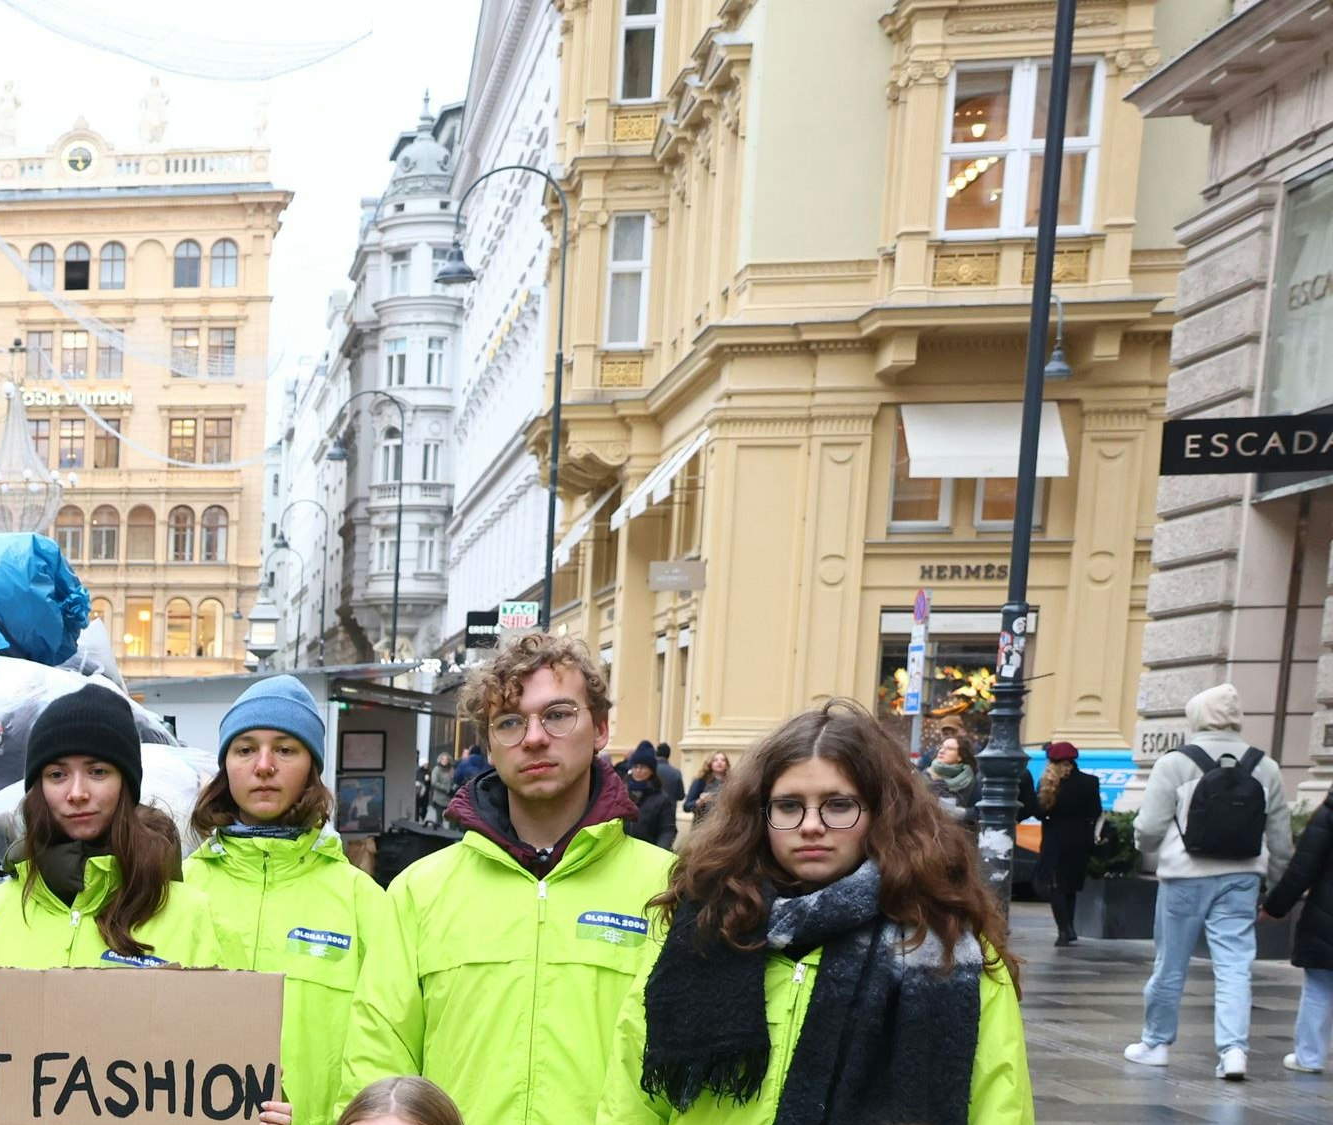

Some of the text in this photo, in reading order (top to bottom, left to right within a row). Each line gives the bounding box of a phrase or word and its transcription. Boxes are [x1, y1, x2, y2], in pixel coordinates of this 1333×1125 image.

[585, 914, 646, 930] GLOBAL 2000
[294, 929, 348, 945] GLOBAL 2000
[33, 1052, 276, 1121] FASHION
